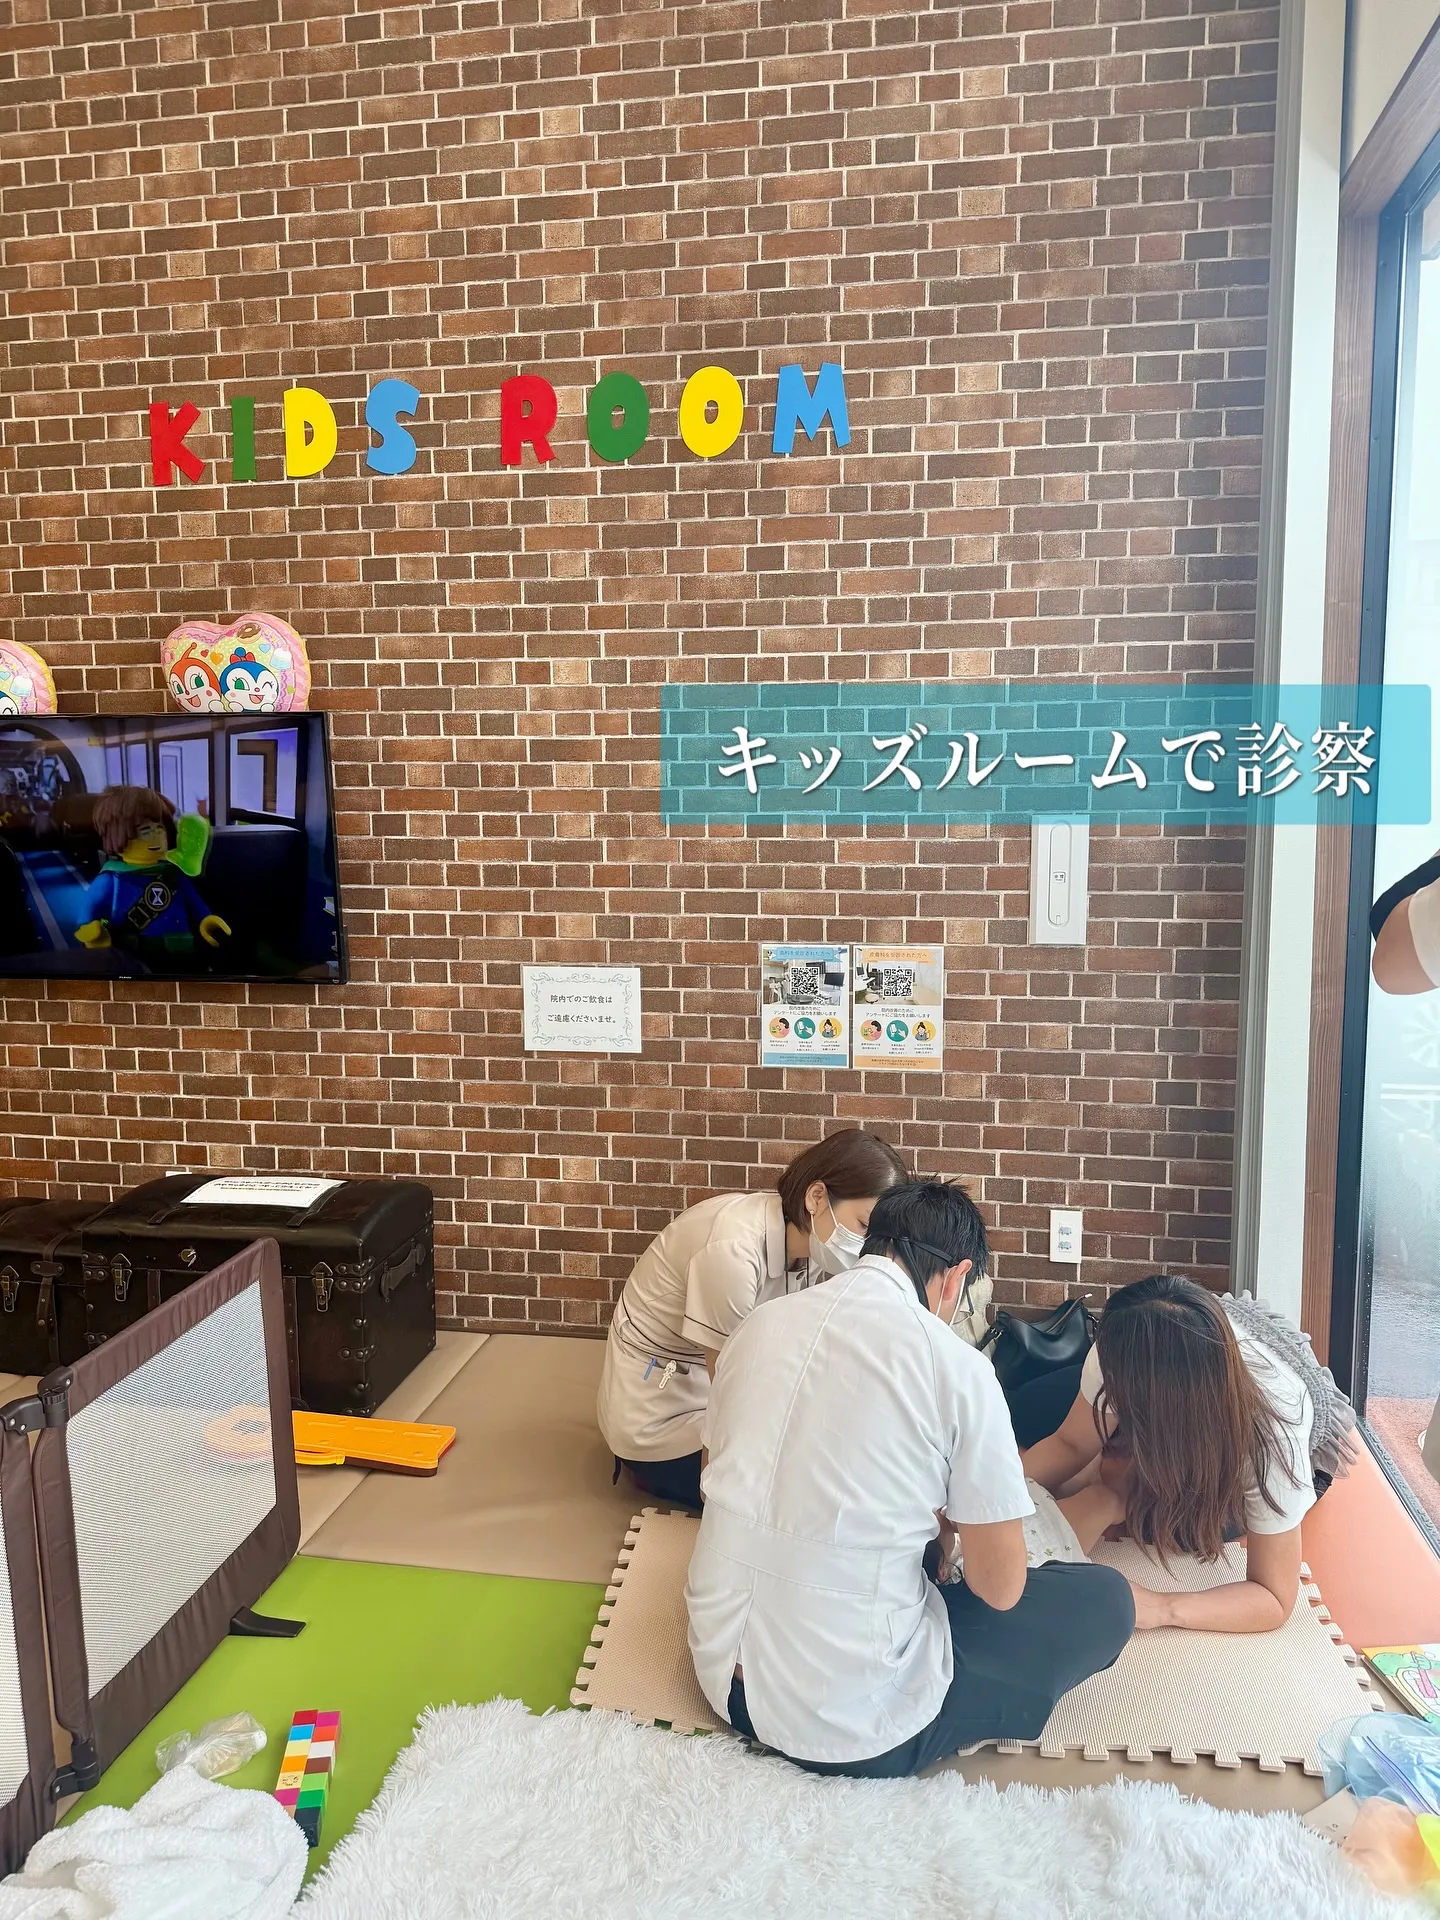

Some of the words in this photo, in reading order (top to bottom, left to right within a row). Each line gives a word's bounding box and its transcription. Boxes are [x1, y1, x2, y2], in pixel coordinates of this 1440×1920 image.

[148, 379, 420, 487] KIDS
[500, 363, 851, 466] ROOM
[550, 994, 613, 1004] 院内でのご飲食は
[547, 1014, 617, 1024] ご遠慮くださいませ。
